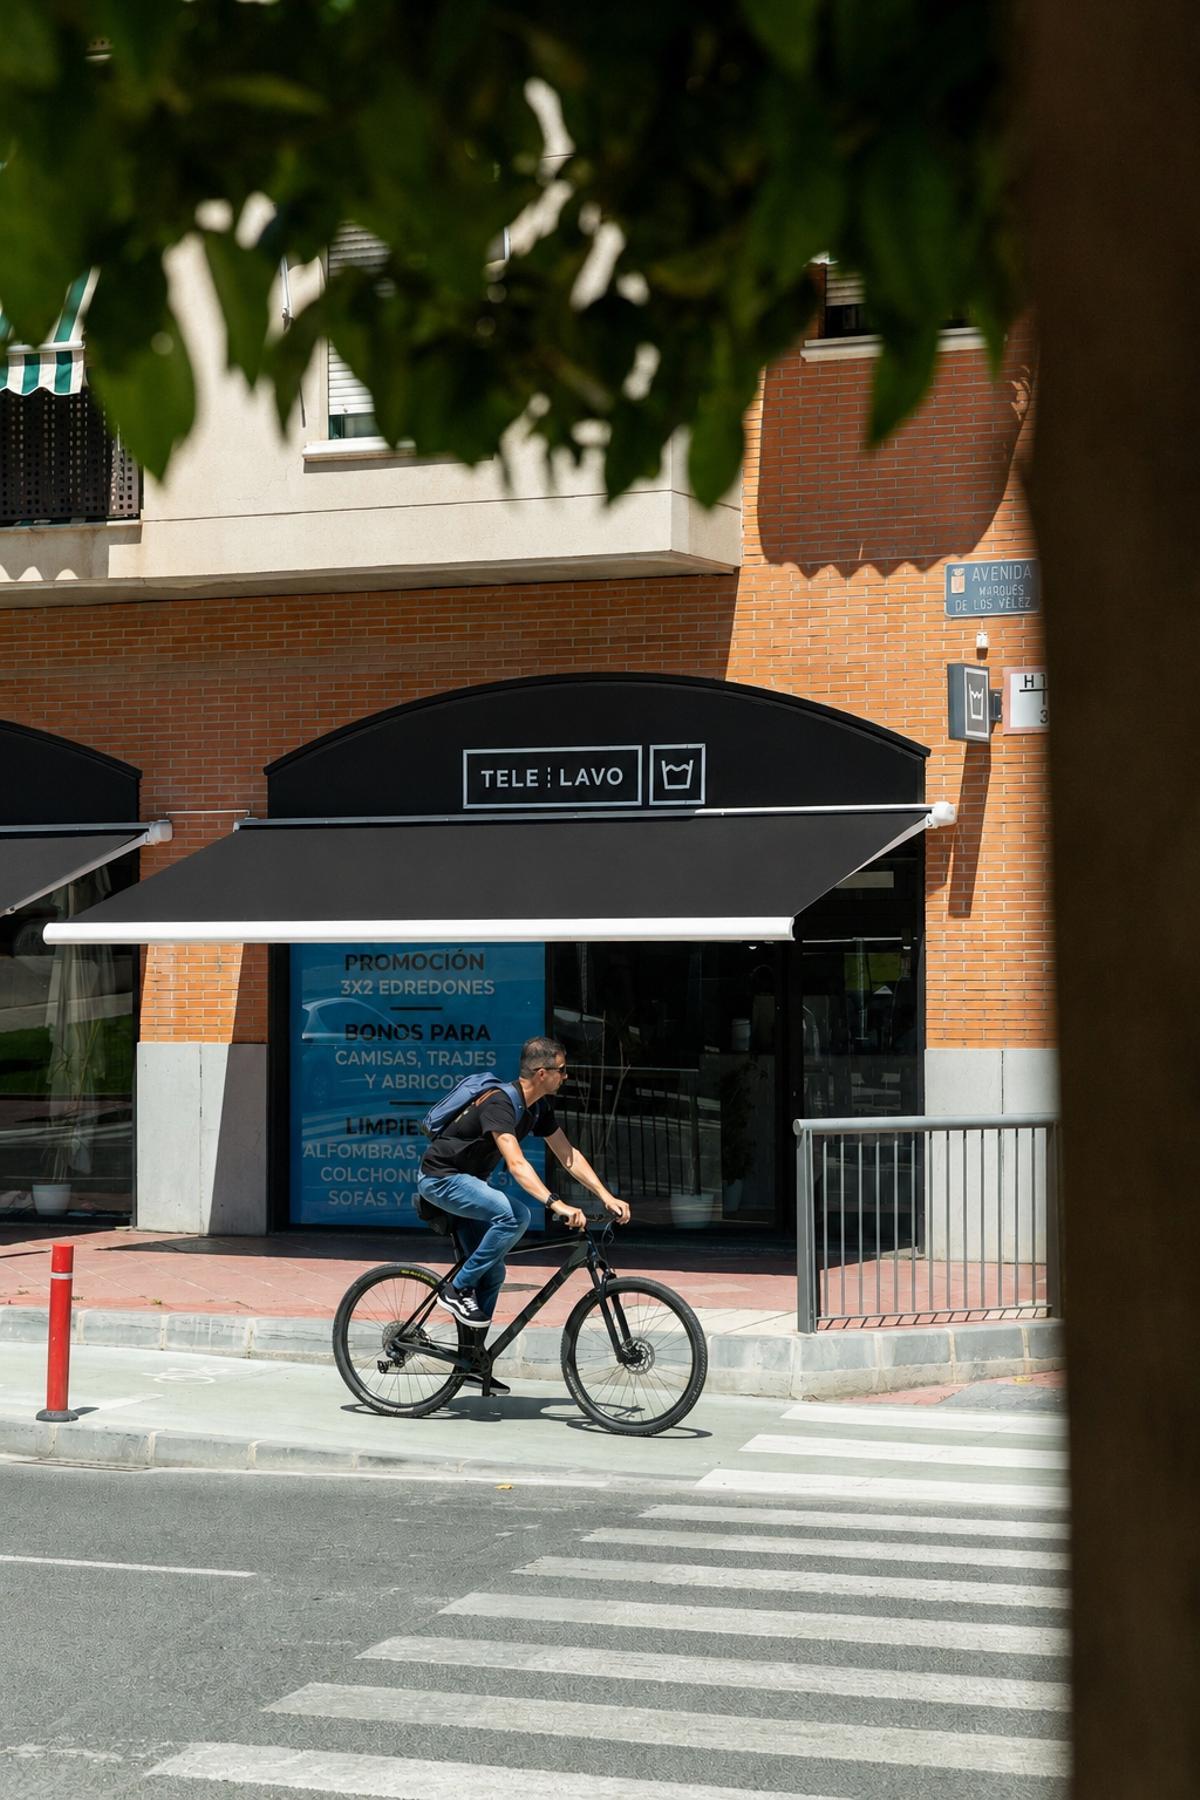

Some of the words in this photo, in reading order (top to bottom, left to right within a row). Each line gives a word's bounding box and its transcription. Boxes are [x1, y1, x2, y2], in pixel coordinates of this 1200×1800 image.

[972, 565, 1032, 582] AVENIDA
[955, 600, 967, 612] DE
[974, 598, 992, 610] LOS
[481, 769, 539, 788] TELE
[559, 767, 623, 786] LAVO
[345, 949, 484, 971] PROMOCIÓN
[341, 980, 373, 995] 3X2
[379, 980, 495, 996] EDREDONES
[345, 1023, 423, 1041] BONOS
[431, 1023, 491, 1041] PARA
[335, 1050, 422, 1068] CAMISAS,
[428, 1051, 497, 1067] TRAJES
[365, 1074, 376, 1088] Y
[346, 1117, 424, 1136] LIMPIE
[303, 1143, 421, 1163] ALFOMBRAS,
[328, 1187, 388, 1206] SOFÁS
[392, 1191, 405, 1206] Y
